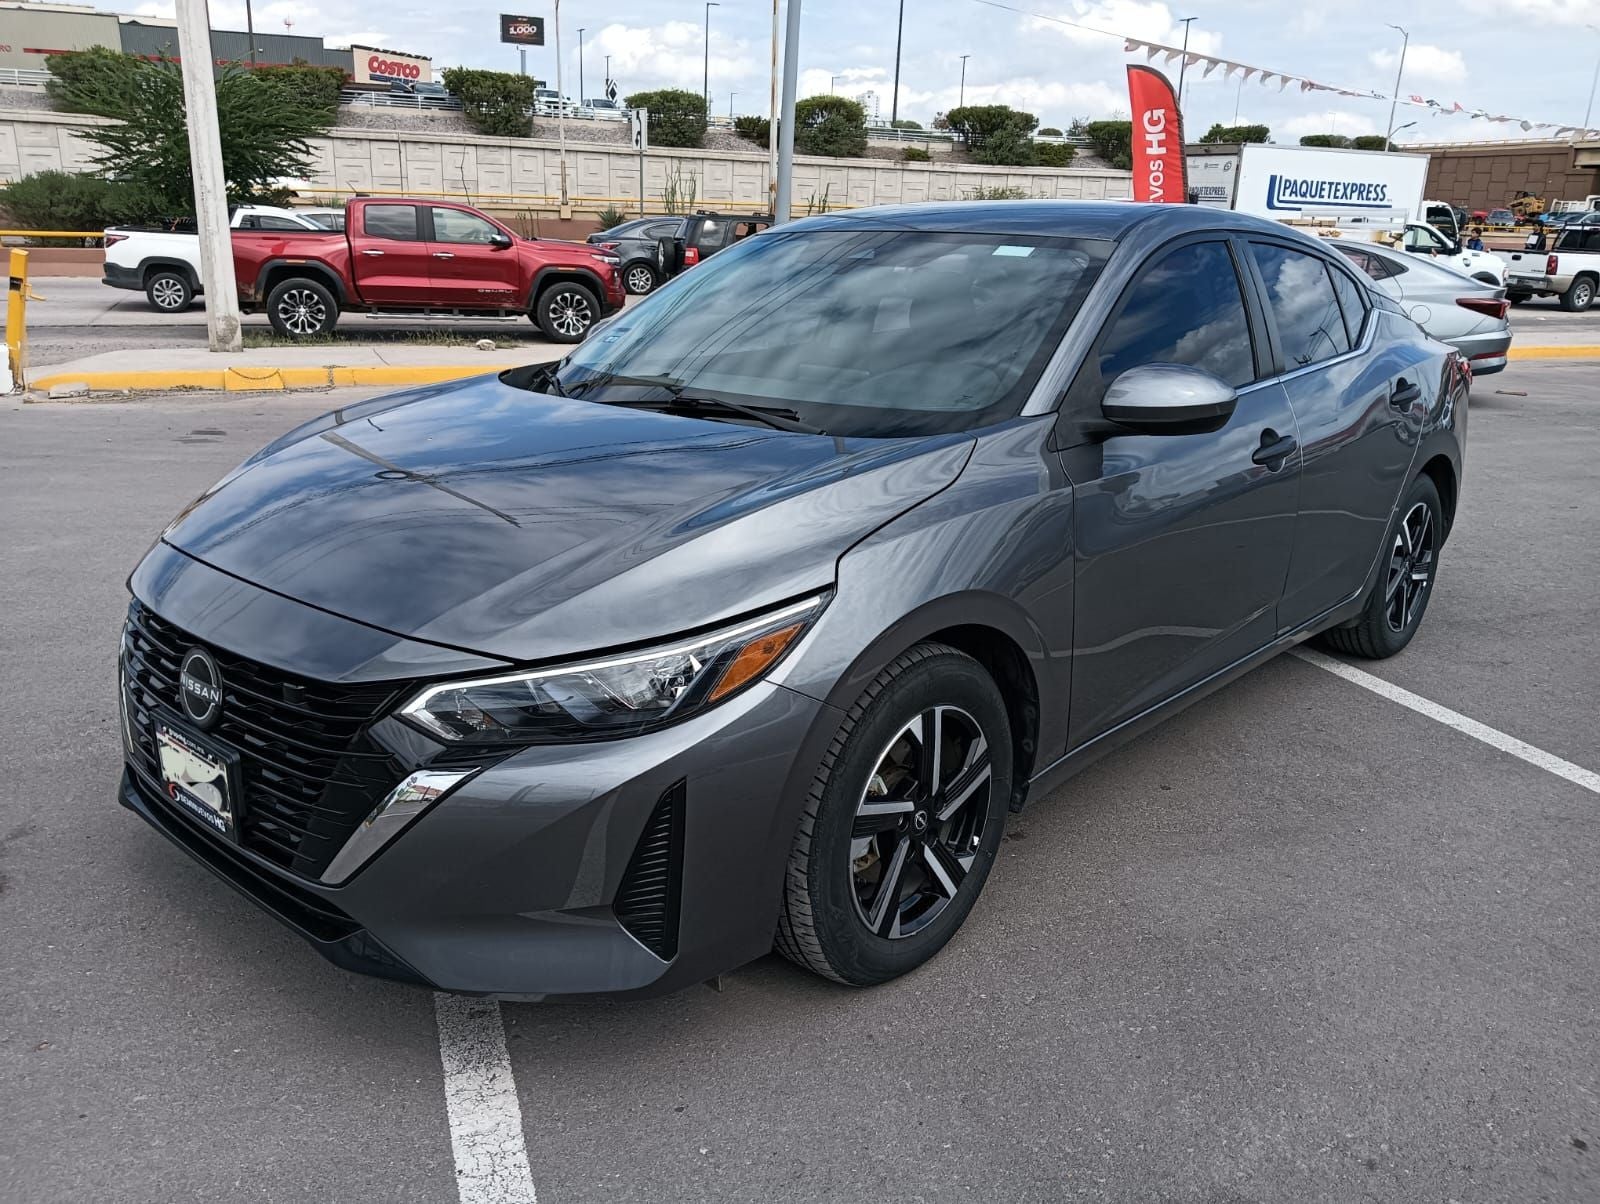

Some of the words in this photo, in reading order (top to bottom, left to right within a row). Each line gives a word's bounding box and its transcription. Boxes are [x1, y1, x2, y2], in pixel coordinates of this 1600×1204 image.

[368, 56, 420, 79] COSTCO
[1143, 108, 1167, 155] HG
[1149, 159, 1164, 202] VOS
[1282, 178, 1387, 202] PAQUETEXPRESS
[181, 672, 219, 702] NISSAN
